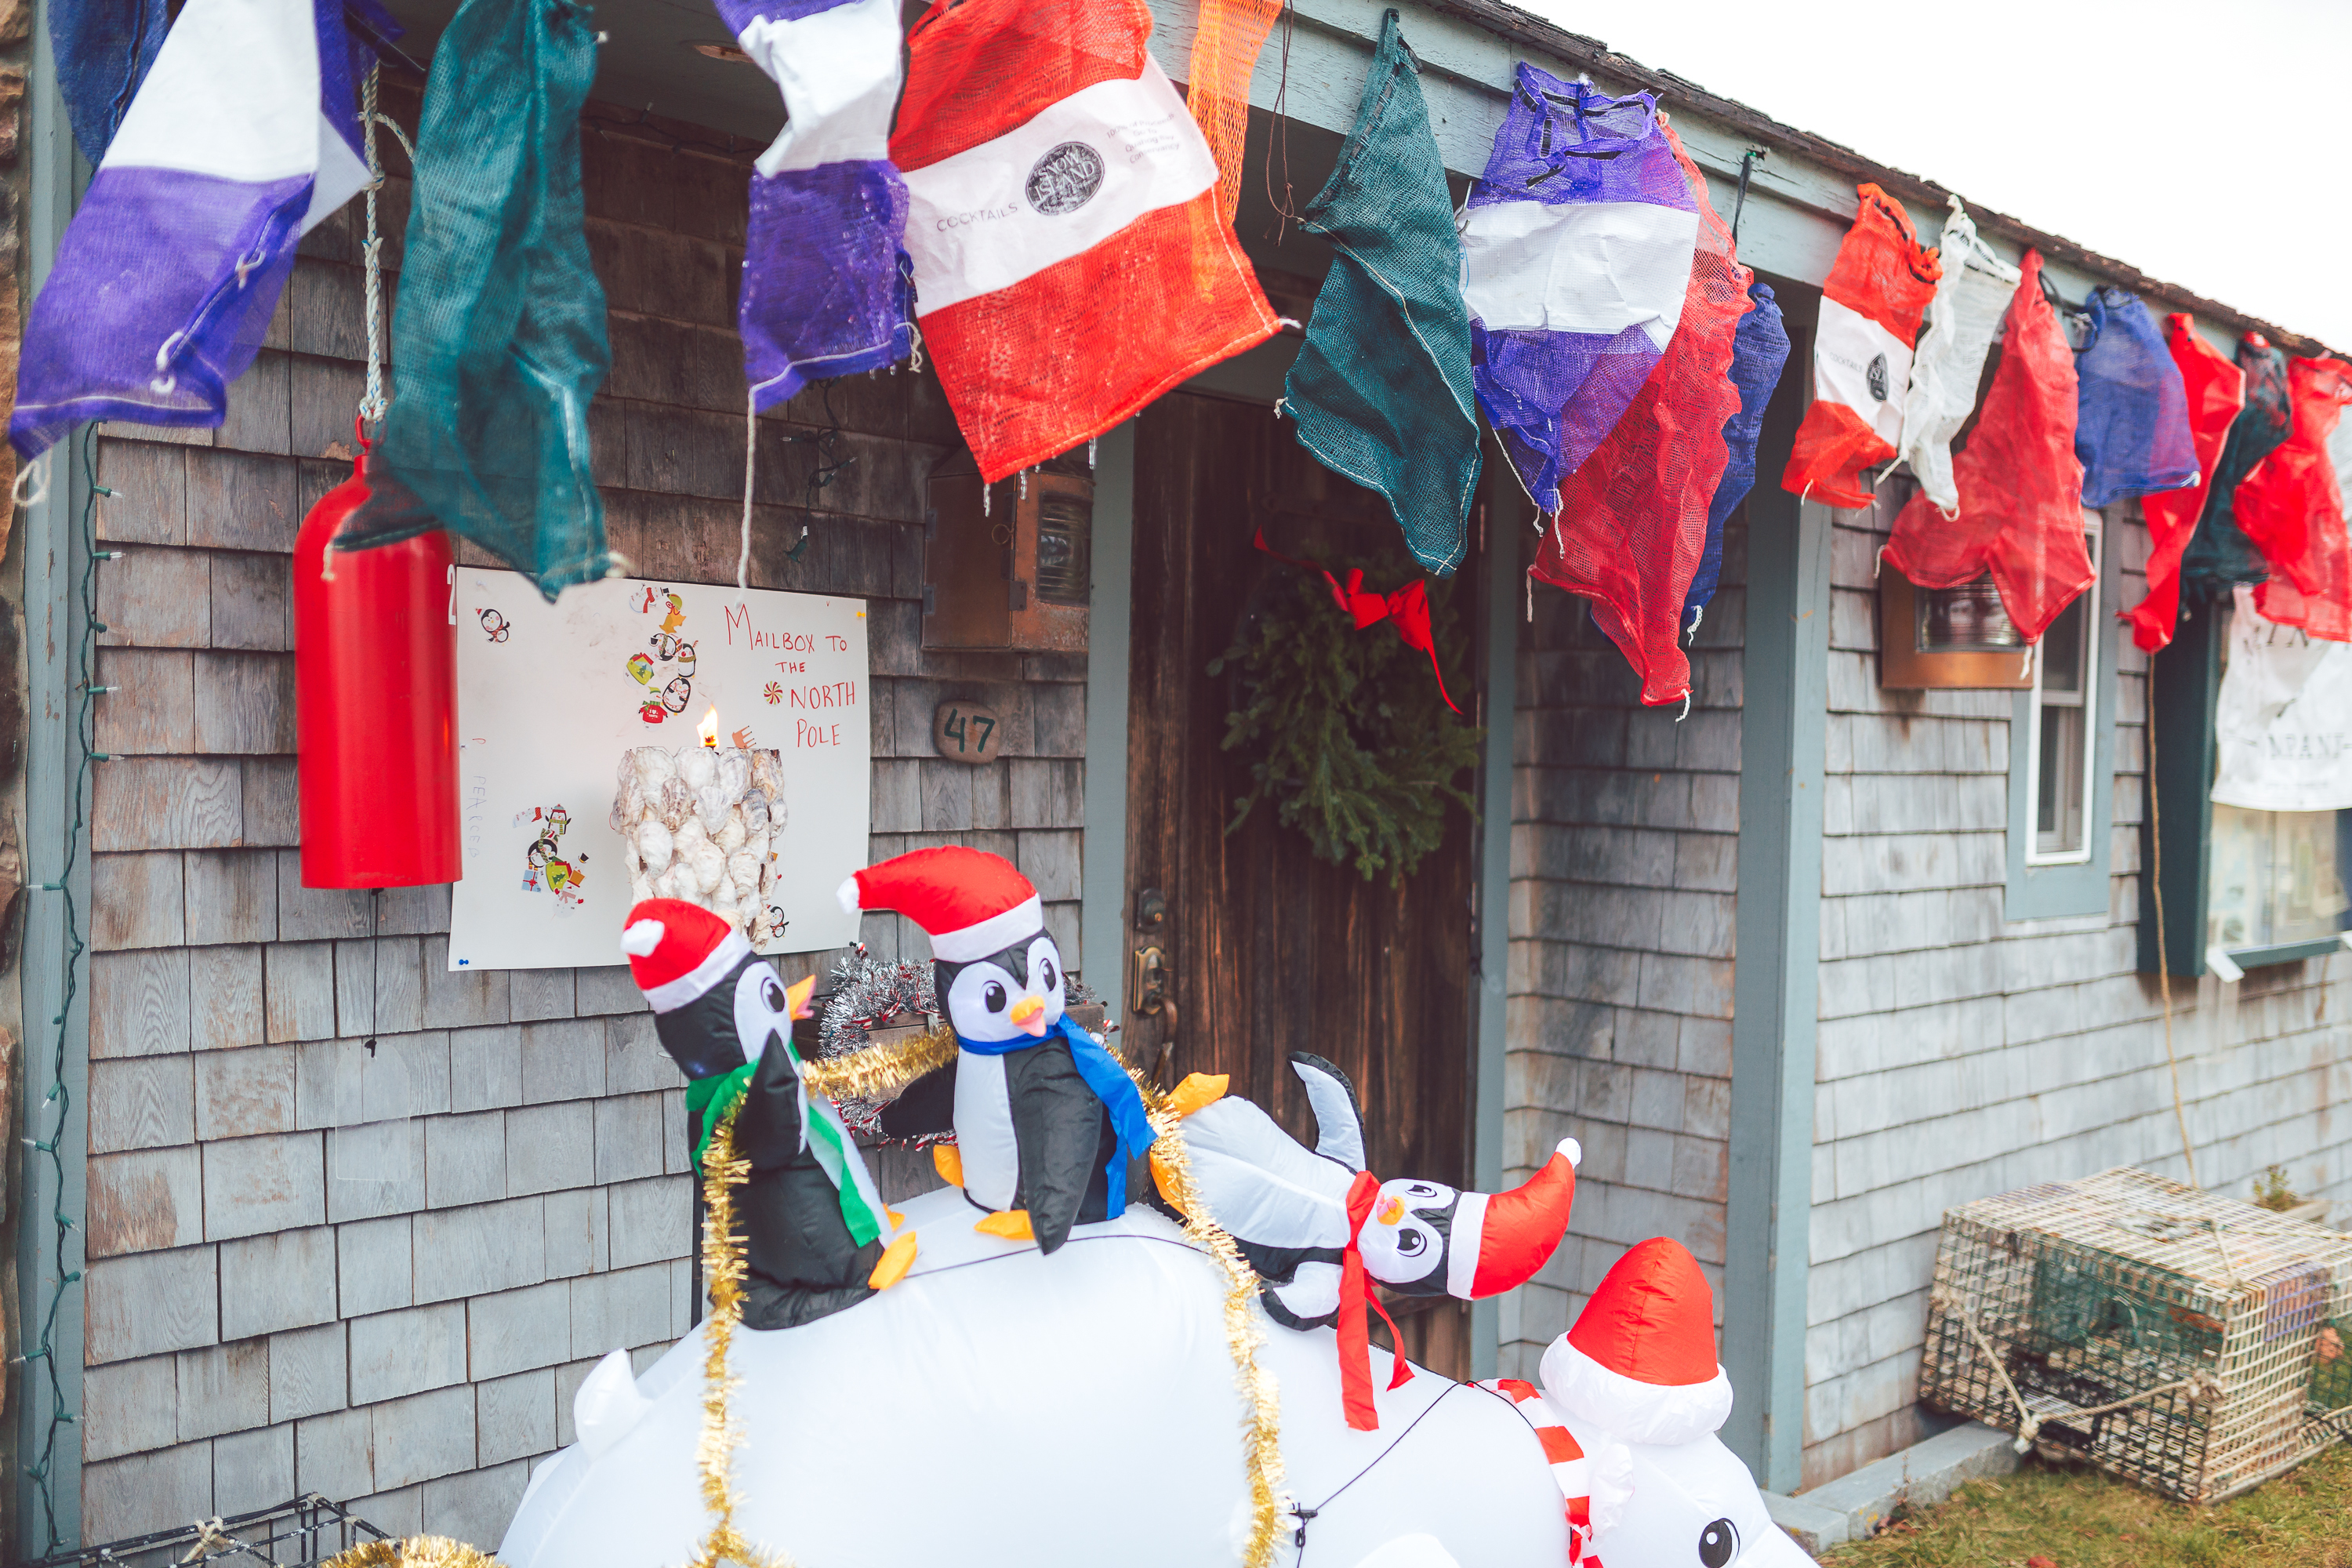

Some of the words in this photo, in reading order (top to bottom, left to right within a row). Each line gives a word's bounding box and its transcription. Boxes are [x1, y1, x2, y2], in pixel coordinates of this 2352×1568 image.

[1034, 160, 1095, 201] ISLAND
[1038, 149, 1080, 181] SNOW
[936, 201, 1018, 232] COCKTAILS
[1829, 351, 1863, 373] COCKTAILS
[724, 603, 815, 654] MAILBOX
[825, 635, 848, 652] TO
[775, 662, 806, 673] THE
[790, 681, 855, 709] NORTH
[797, 718, 840, 748] POLE
[944, 708, 995, 753] 47
